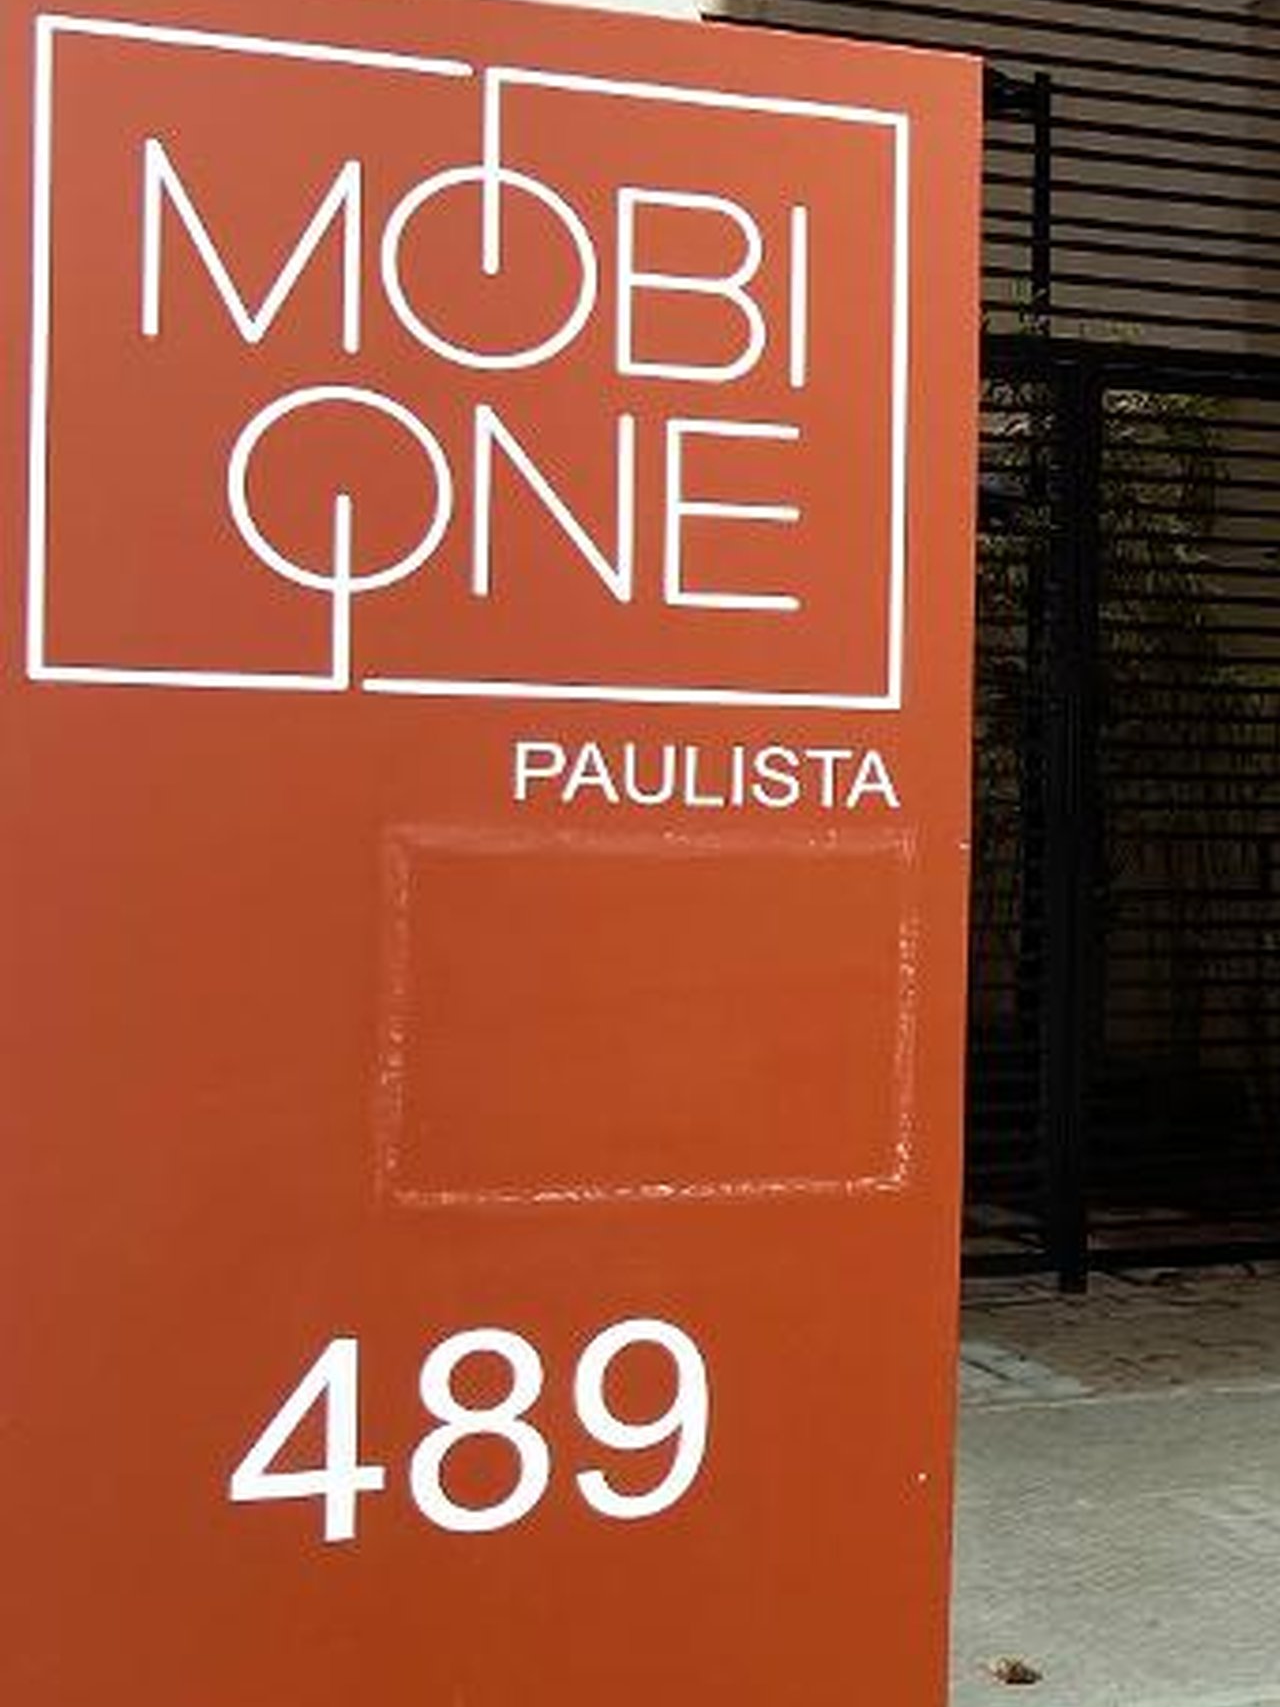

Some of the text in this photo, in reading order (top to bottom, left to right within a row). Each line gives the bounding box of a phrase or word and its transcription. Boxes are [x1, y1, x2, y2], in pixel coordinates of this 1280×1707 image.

[143, 137, 807, 387] MOBI
[227, 385, 801, 612] ONE
[512, 741, 901, 808] PAULISTA
[229, 1318, 709, 1542] 489
